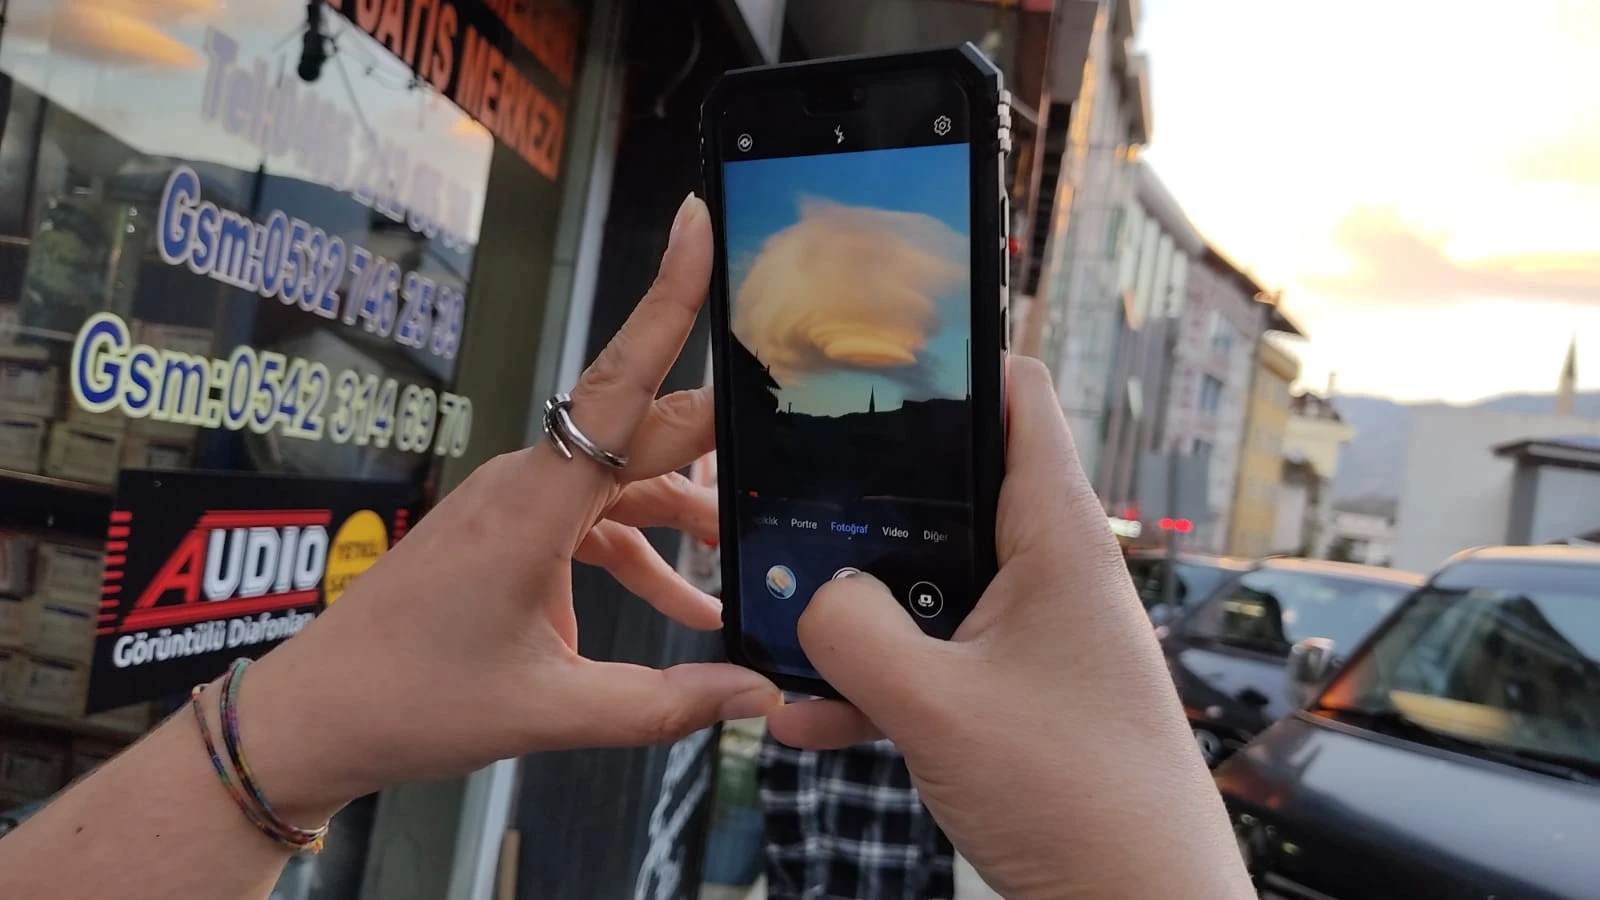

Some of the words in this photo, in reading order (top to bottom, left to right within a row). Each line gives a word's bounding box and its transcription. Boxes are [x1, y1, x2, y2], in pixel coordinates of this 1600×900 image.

[157, 166, 346, 320] Gsm:0532
[343, 243, 400, 338] 746
[71, 312, 330, 441] Gsm:0542
[329, 369, 398, 449] 314
[395, 383, 437, 454] 69
[434, 391, 473, 458] 70
[131, 522, 330, 610] AUDIO
[791, 518, 818, 530] Portre
[830, 521, 869, 535] Fotoğraf
[882, 526, 909, 539] Video
[923, 530, 949, 543] Diğer
[112, 616, 227, 668] Görüntülü
